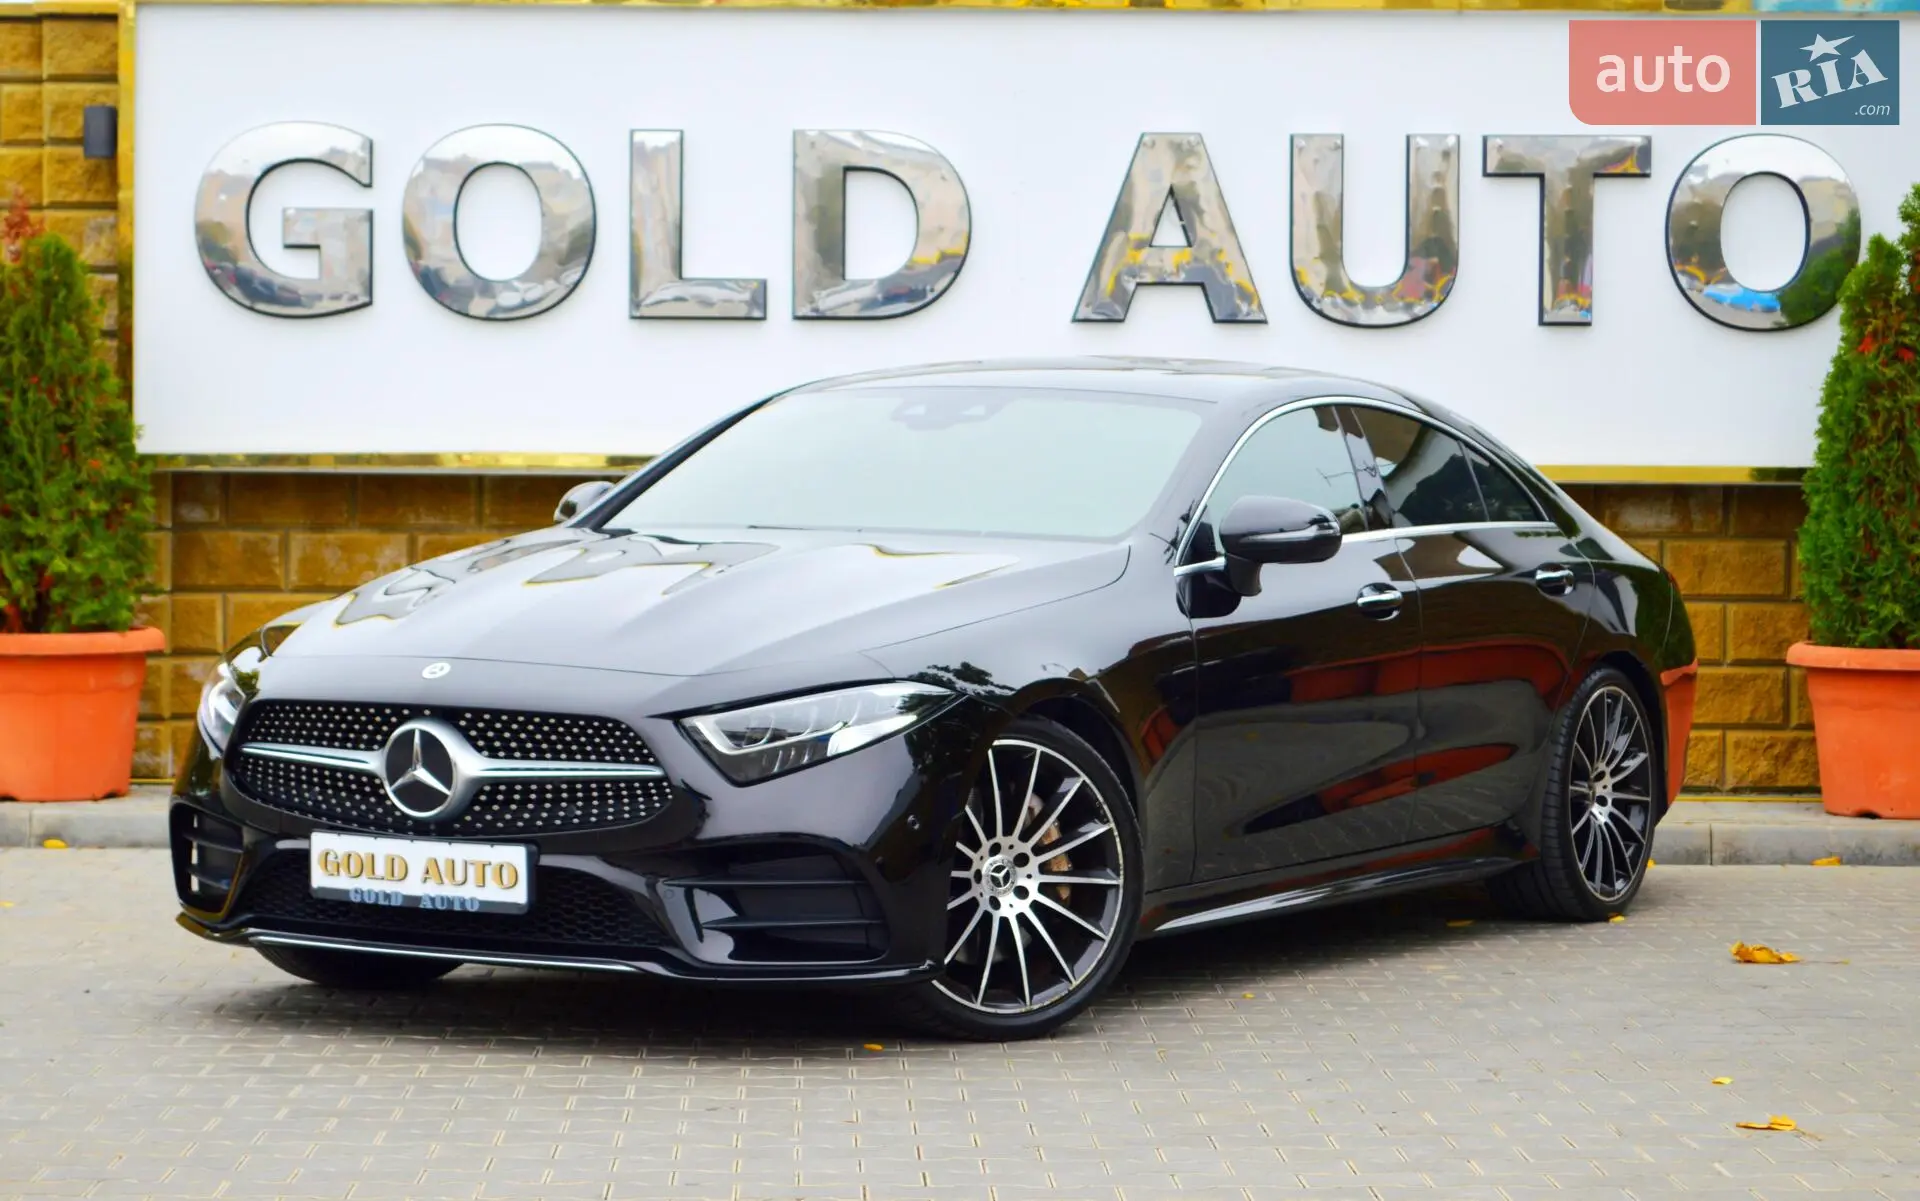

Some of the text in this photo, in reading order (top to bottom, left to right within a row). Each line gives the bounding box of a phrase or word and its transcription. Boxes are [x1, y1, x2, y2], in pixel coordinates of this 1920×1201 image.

[194, 121, 1861, 332] GOLD AUTO
[318, 848, 519, 889] GOLD AUTO
[350, 888, 480, 912] GOLD AUTO
